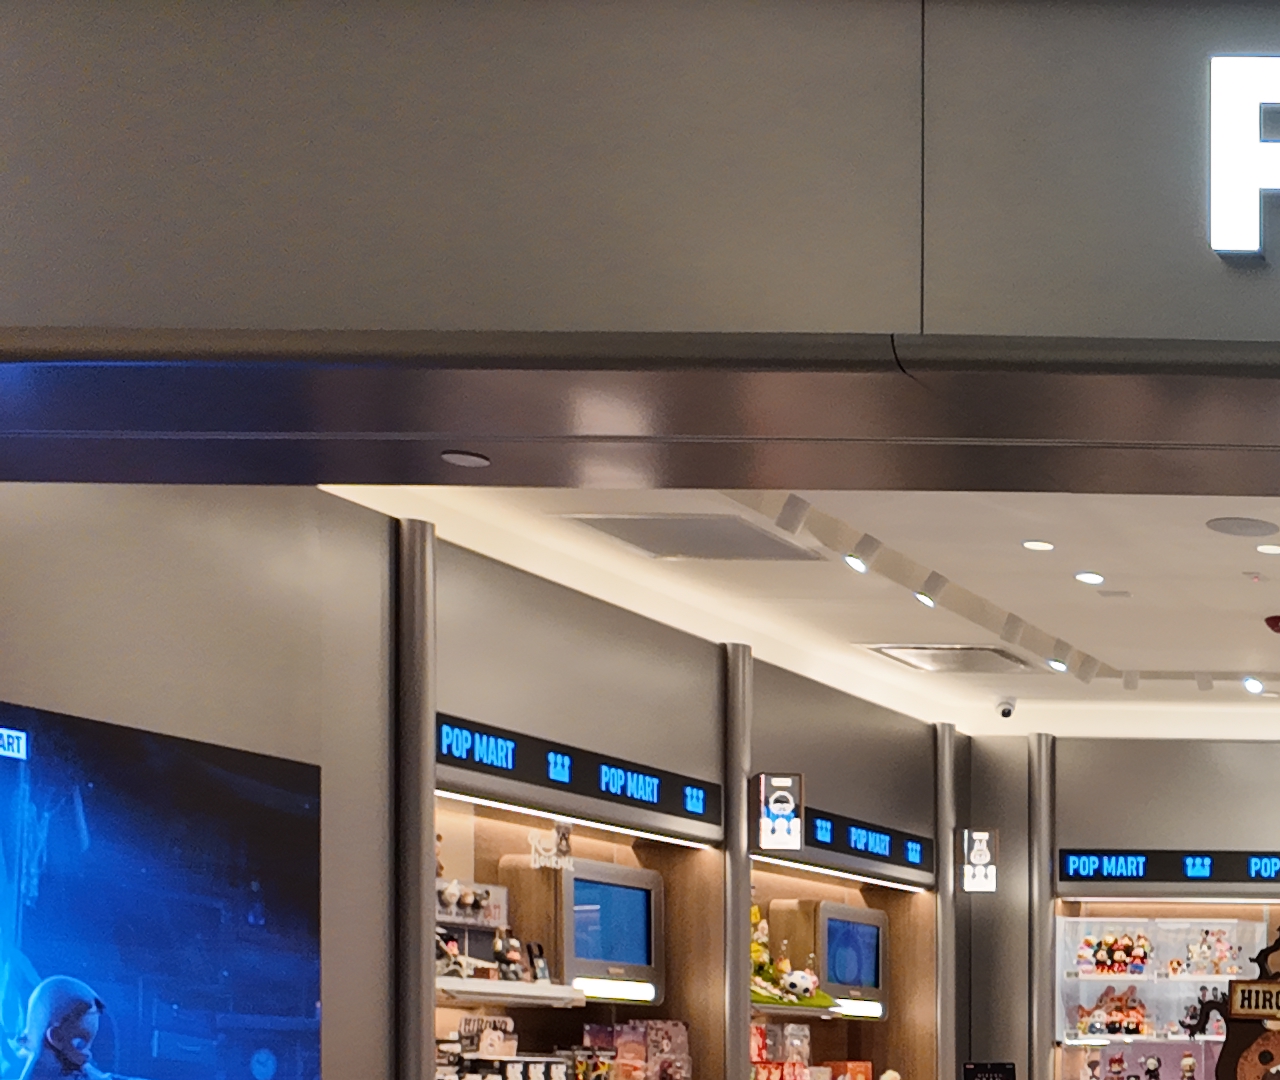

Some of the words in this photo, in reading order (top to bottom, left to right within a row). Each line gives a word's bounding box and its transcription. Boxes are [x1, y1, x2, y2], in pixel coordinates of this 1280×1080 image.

[441, 724, 472, 760] POP
[474, 733, 515, 769] MART
[601, 765, 625, 795] POP
[627, 771, 659, 803] MART
[850, 826, 867, 850] POP
[868, 830, 891, 857] MART
[1068, 855, 1099, 877] POP
[1103, 856, 1146, 878] MART
[1250, 856, 1280, 878] POP
